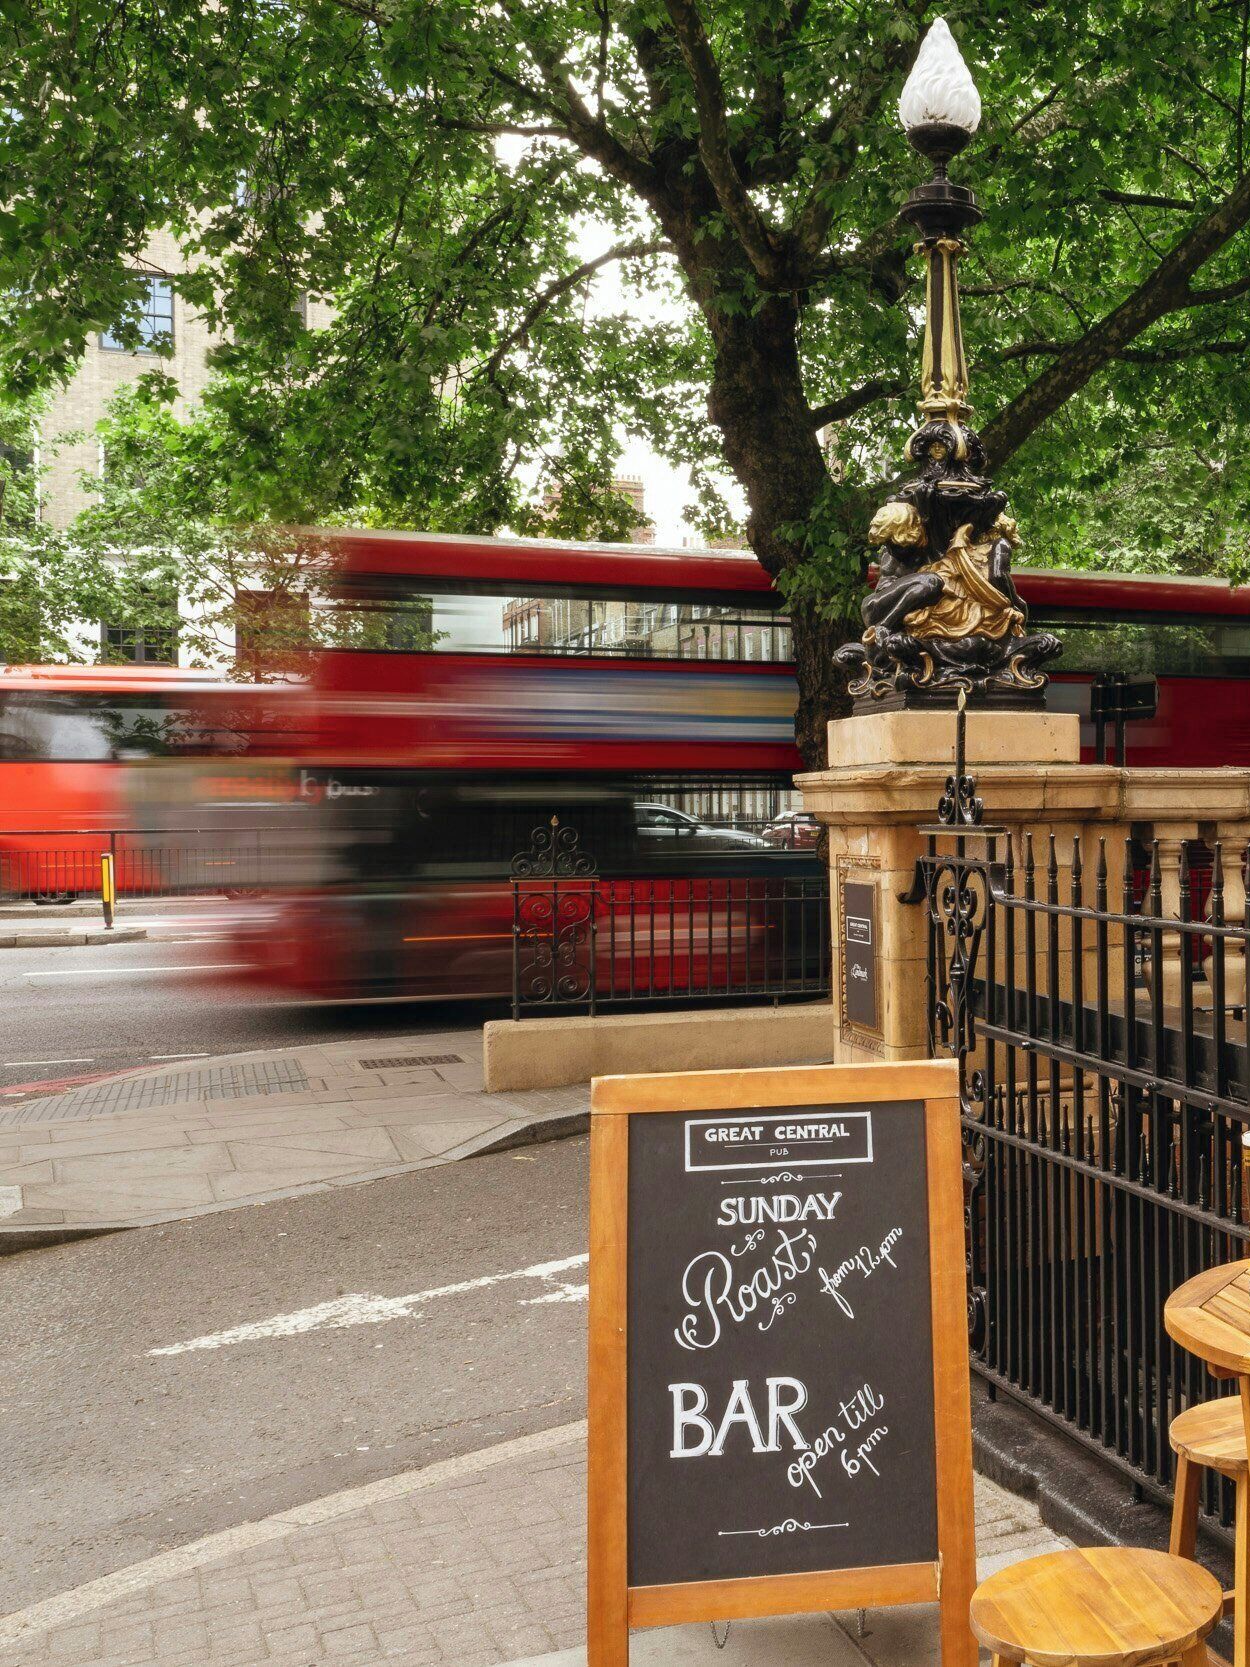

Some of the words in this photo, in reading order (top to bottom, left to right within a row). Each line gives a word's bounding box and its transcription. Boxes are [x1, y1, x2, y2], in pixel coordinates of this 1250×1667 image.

[704, 1126, 764, 1142] GREAT
[774, 1123, 850, 1140] CENTRAL
[769, 1148, 789, 1156] PUB
[717, 1191, 842, 1226] SUNDAY
[682, 1228, 811, 1349] Roast
[818, 1259, 856, 1319] from
[668, 1376, 812, 1458] BAR
[787, 1426, 846, 1499] open
[838, 1383, 885, 1430] till
[840, 1426, 889, 1479] 6pm
